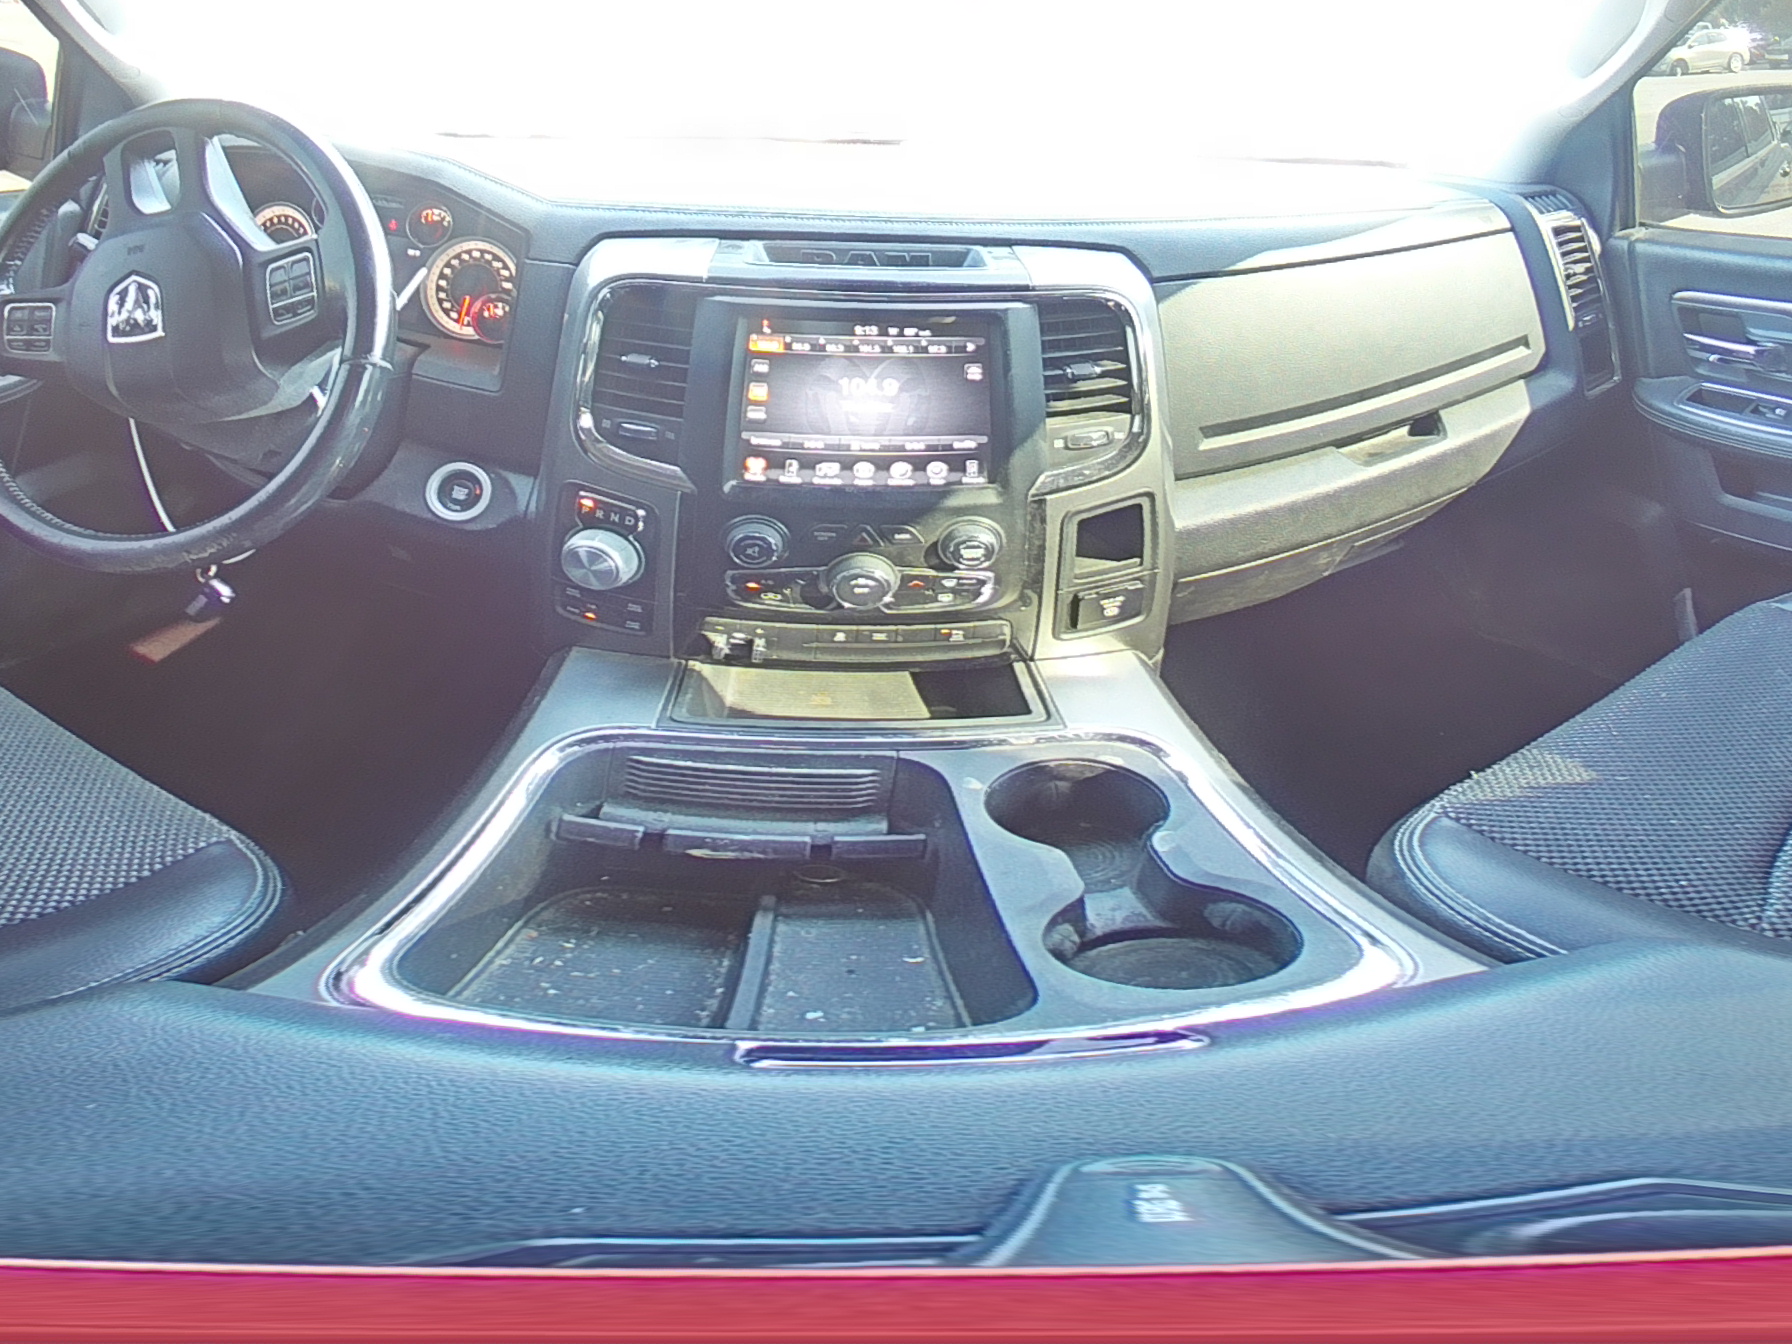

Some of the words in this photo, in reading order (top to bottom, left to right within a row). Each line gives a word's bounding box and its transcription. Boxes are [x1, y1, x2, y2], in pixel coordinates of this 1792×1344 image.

[800, 250, 933, 267] RAM
[838, 376, 900, 397] 104.9
[595, 509, 605, 519] R
[610, 512, 620, 523] N
[624, 516, 635, 526] D
